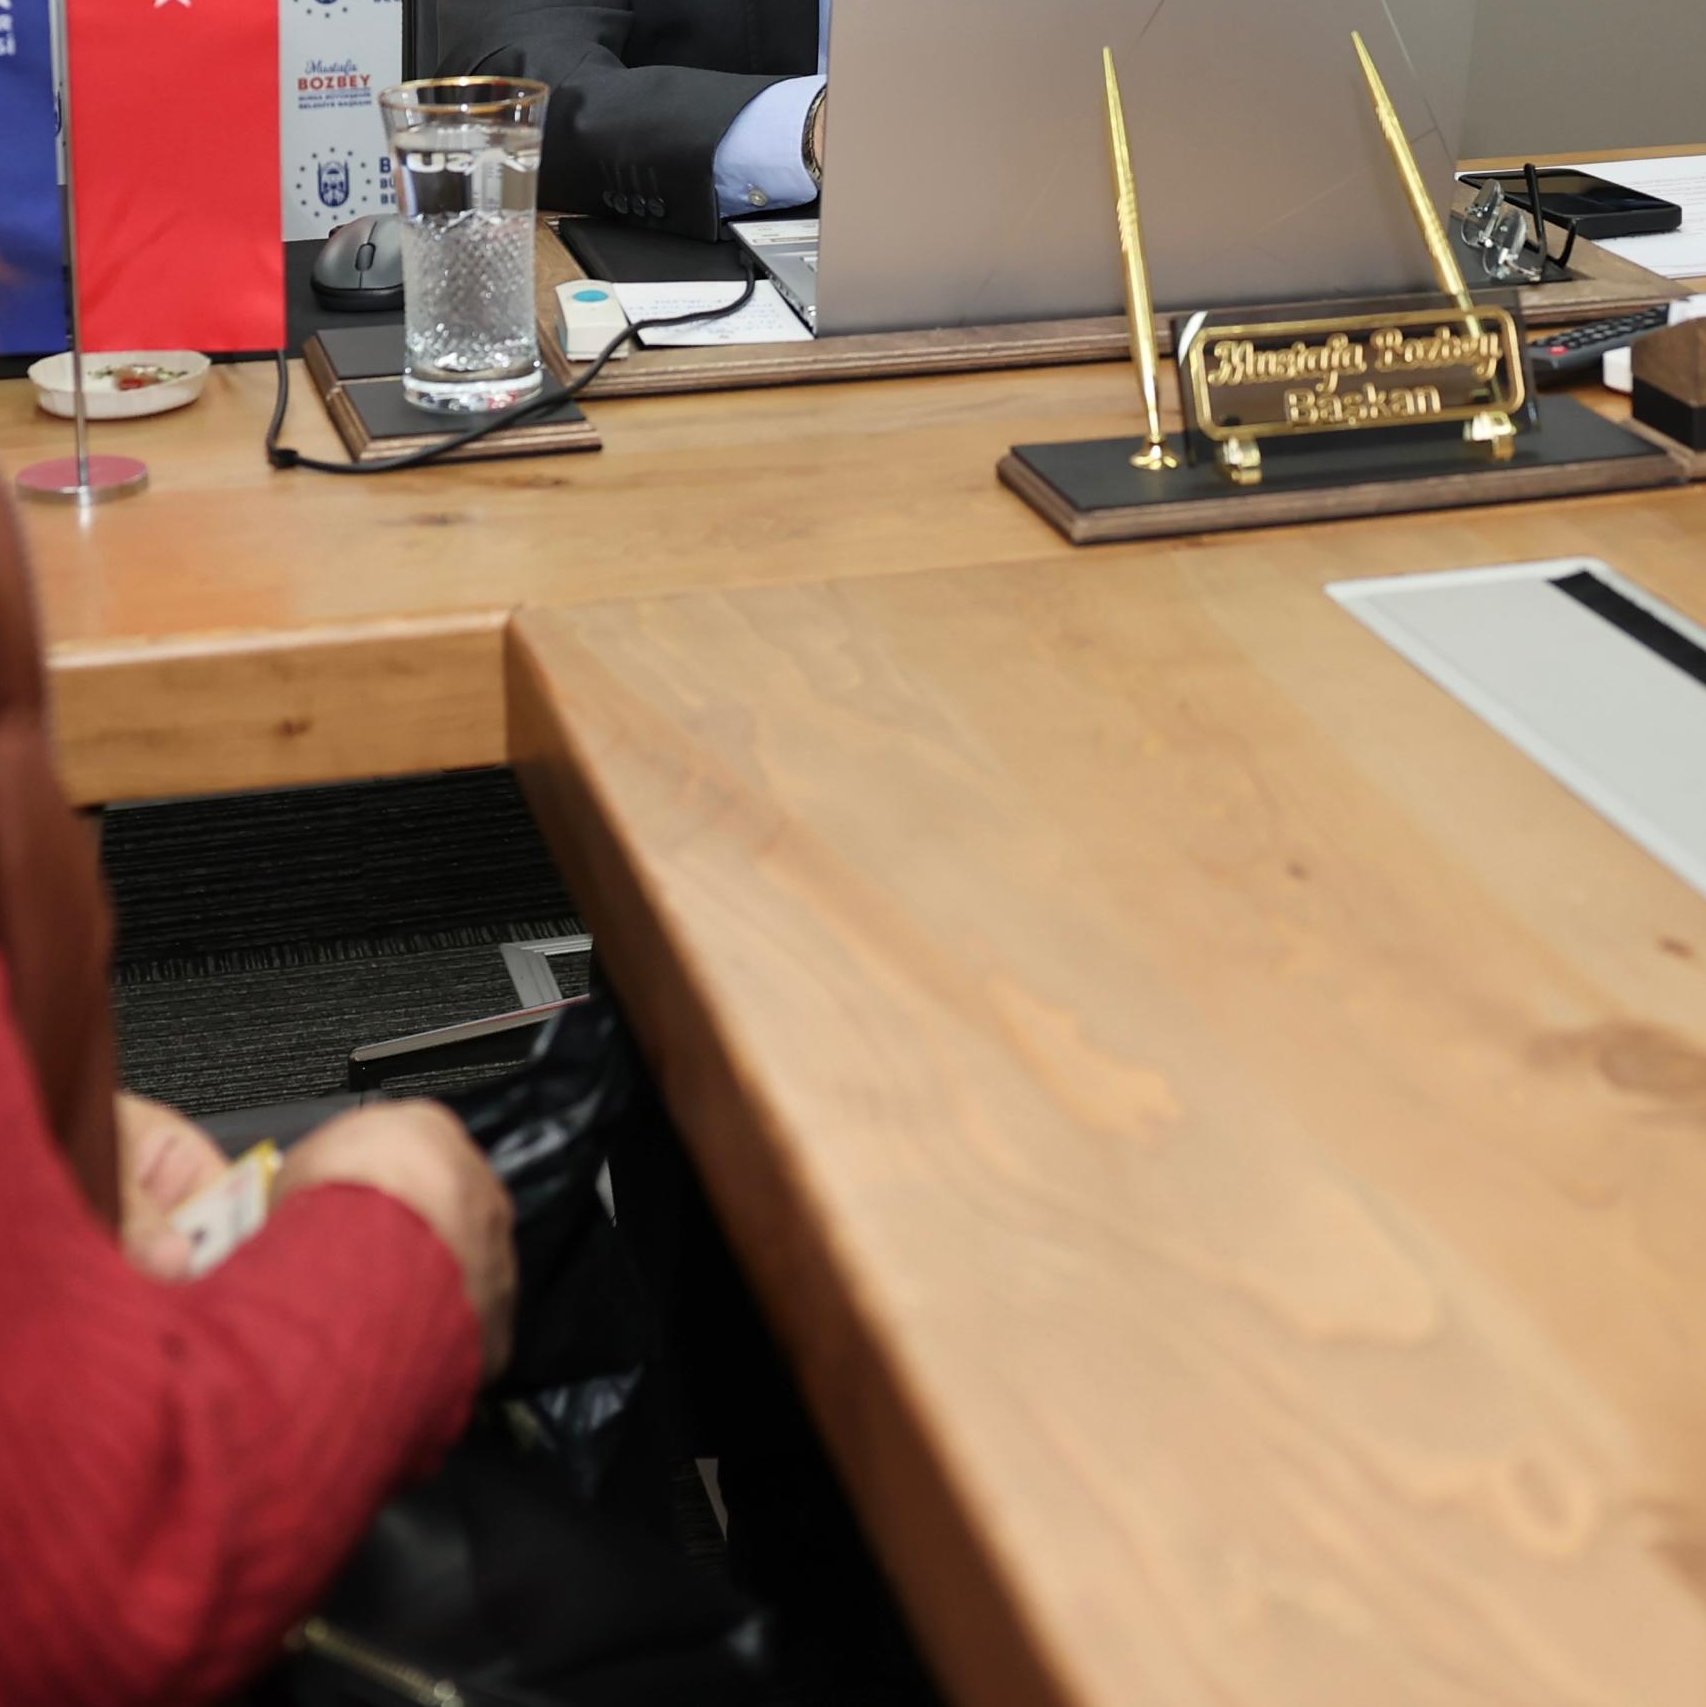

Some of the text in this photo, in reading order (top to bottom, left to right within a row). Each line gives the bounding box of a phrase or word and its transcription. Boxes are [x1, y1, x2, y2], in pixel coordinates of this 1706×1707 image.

[305, 59, 357, 76] Mustafa
[297, 75, 371, 91] BOZBEY
[1284, 381, 1442, 425] Başkan
